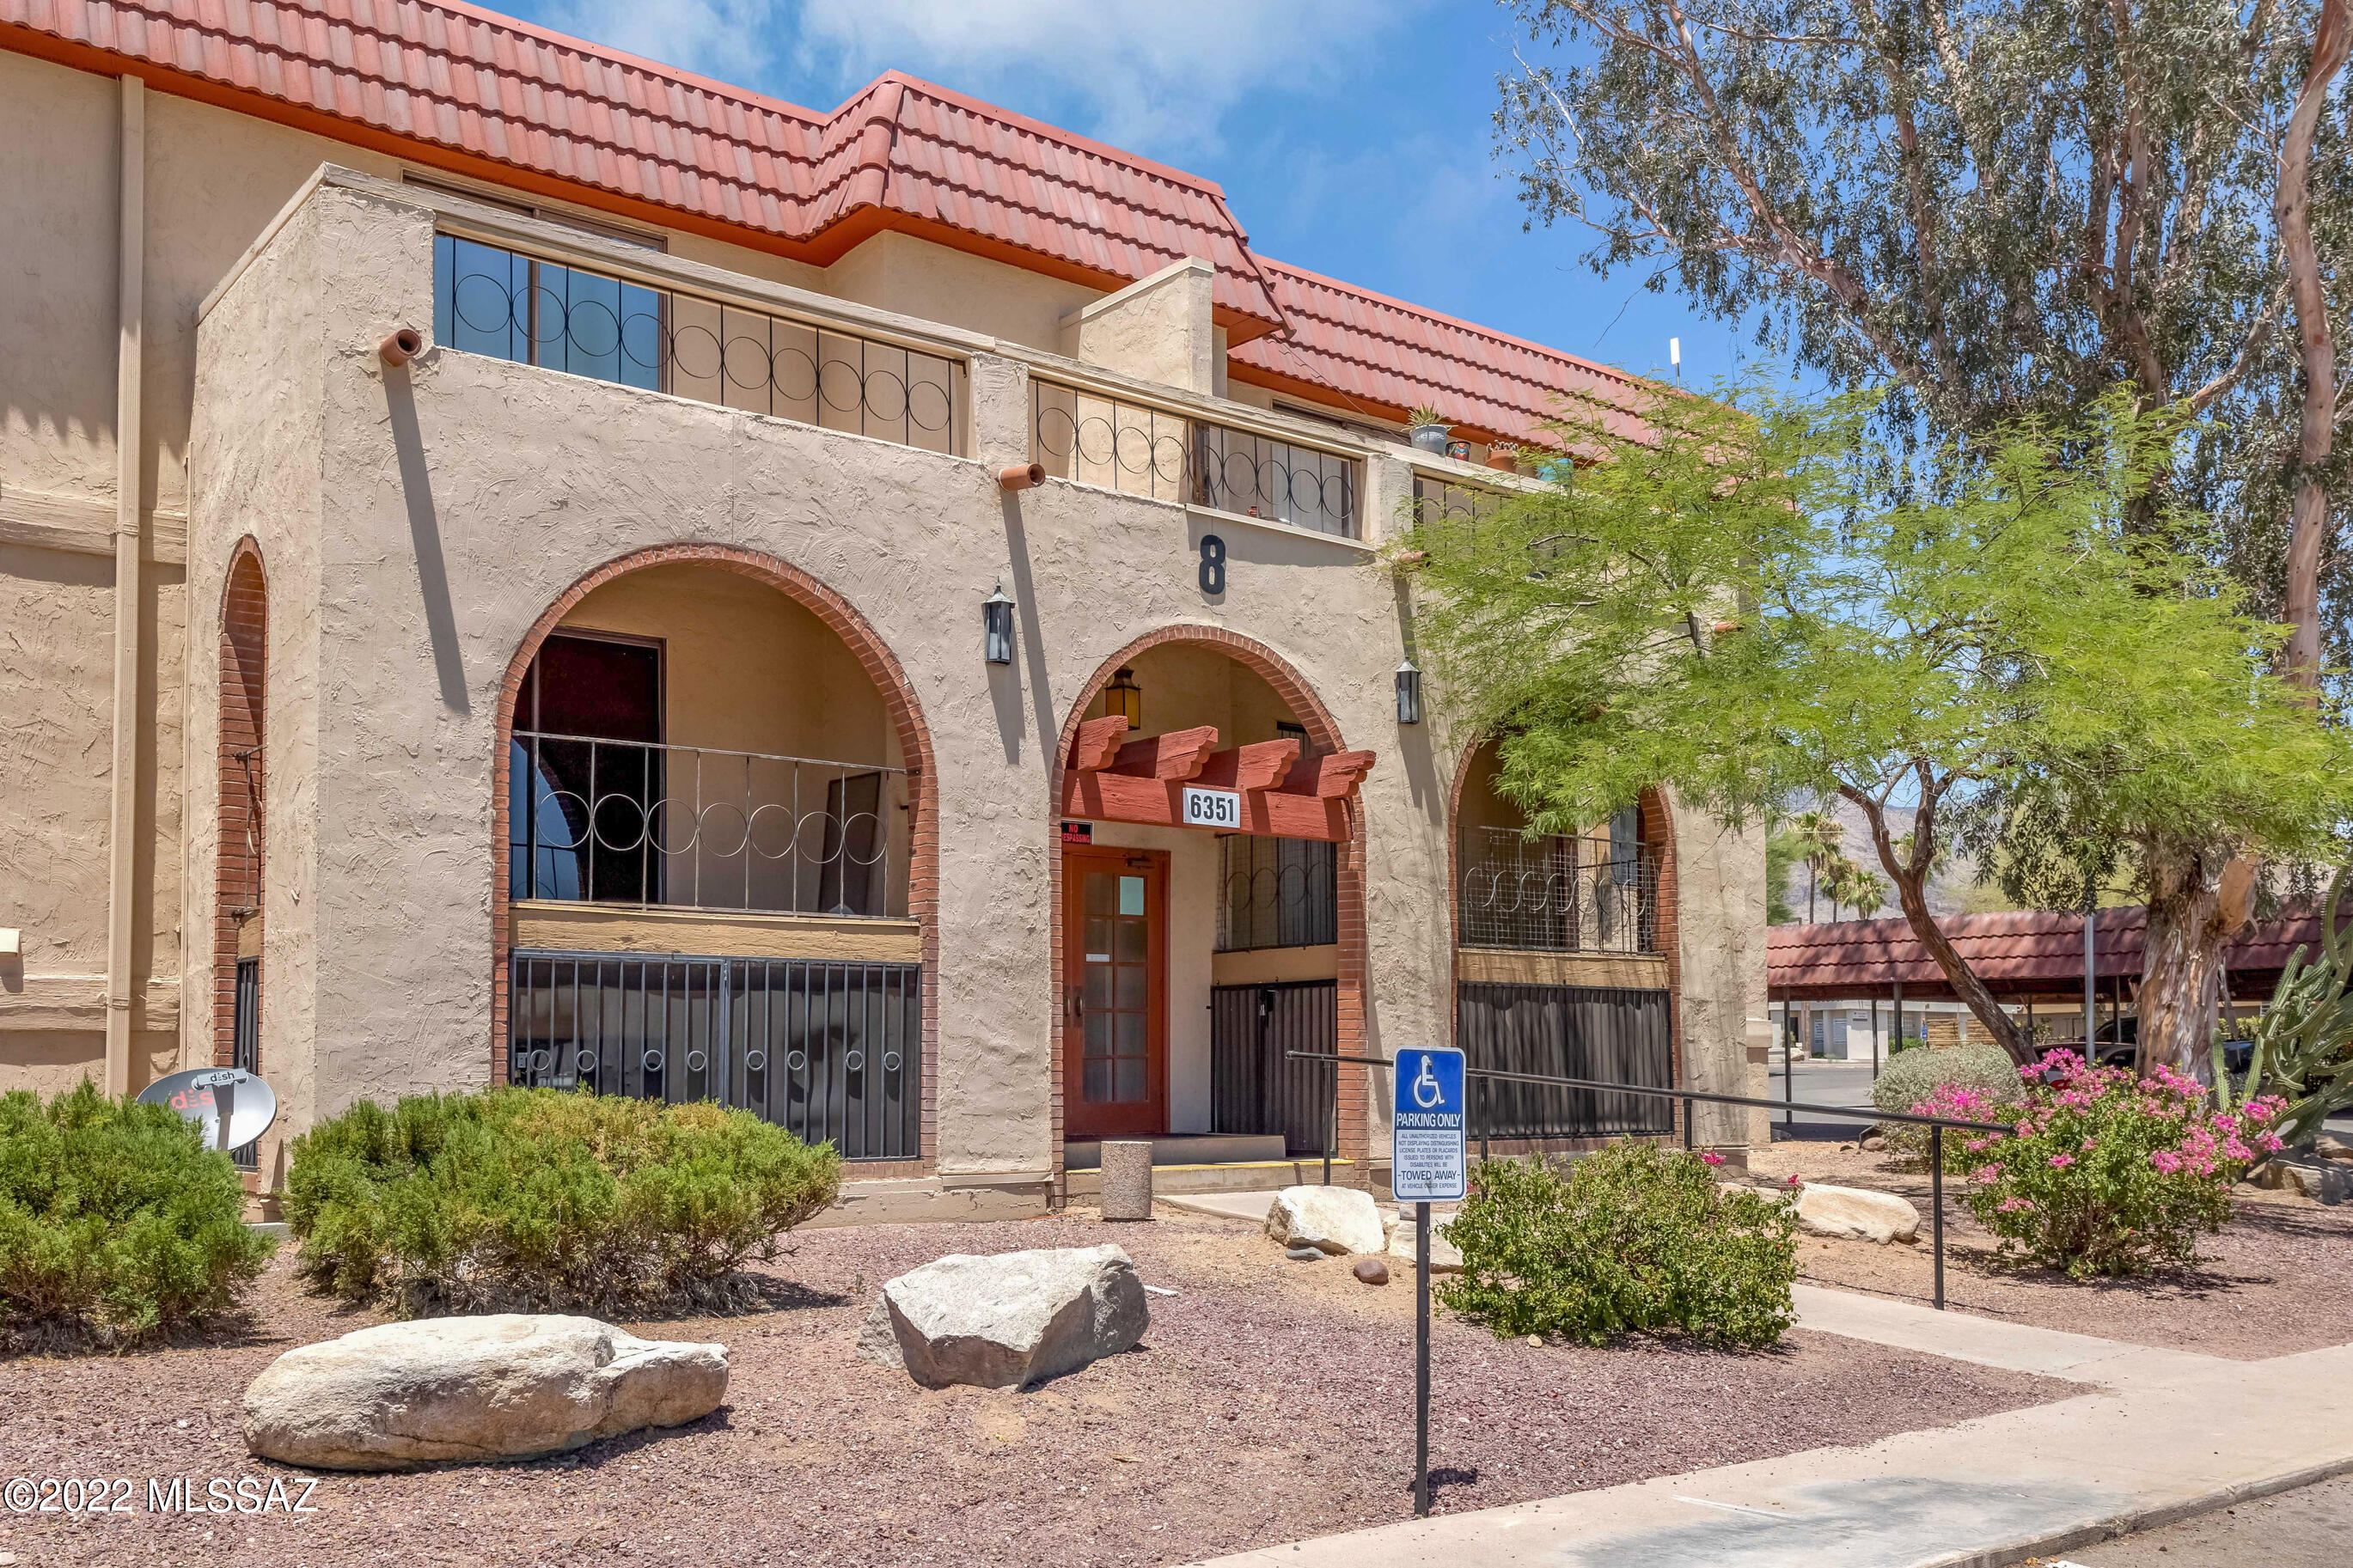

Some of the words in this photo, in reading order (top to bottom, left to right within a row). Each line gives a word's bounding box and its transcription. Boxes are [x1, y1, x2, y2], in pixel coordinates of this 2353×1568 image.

[1199, 534, 1225, 595] 8
[1190, 794, 1234, 821] 6351
[1068, 824, 1079, 833] NO
[210, 1071, 235, 1082] dish
[171, 1089, 215, 1110] dis
[1397, 1113, 1436, 1127] PARKING
[1437, 1113, 1461, 1127] ONLY
